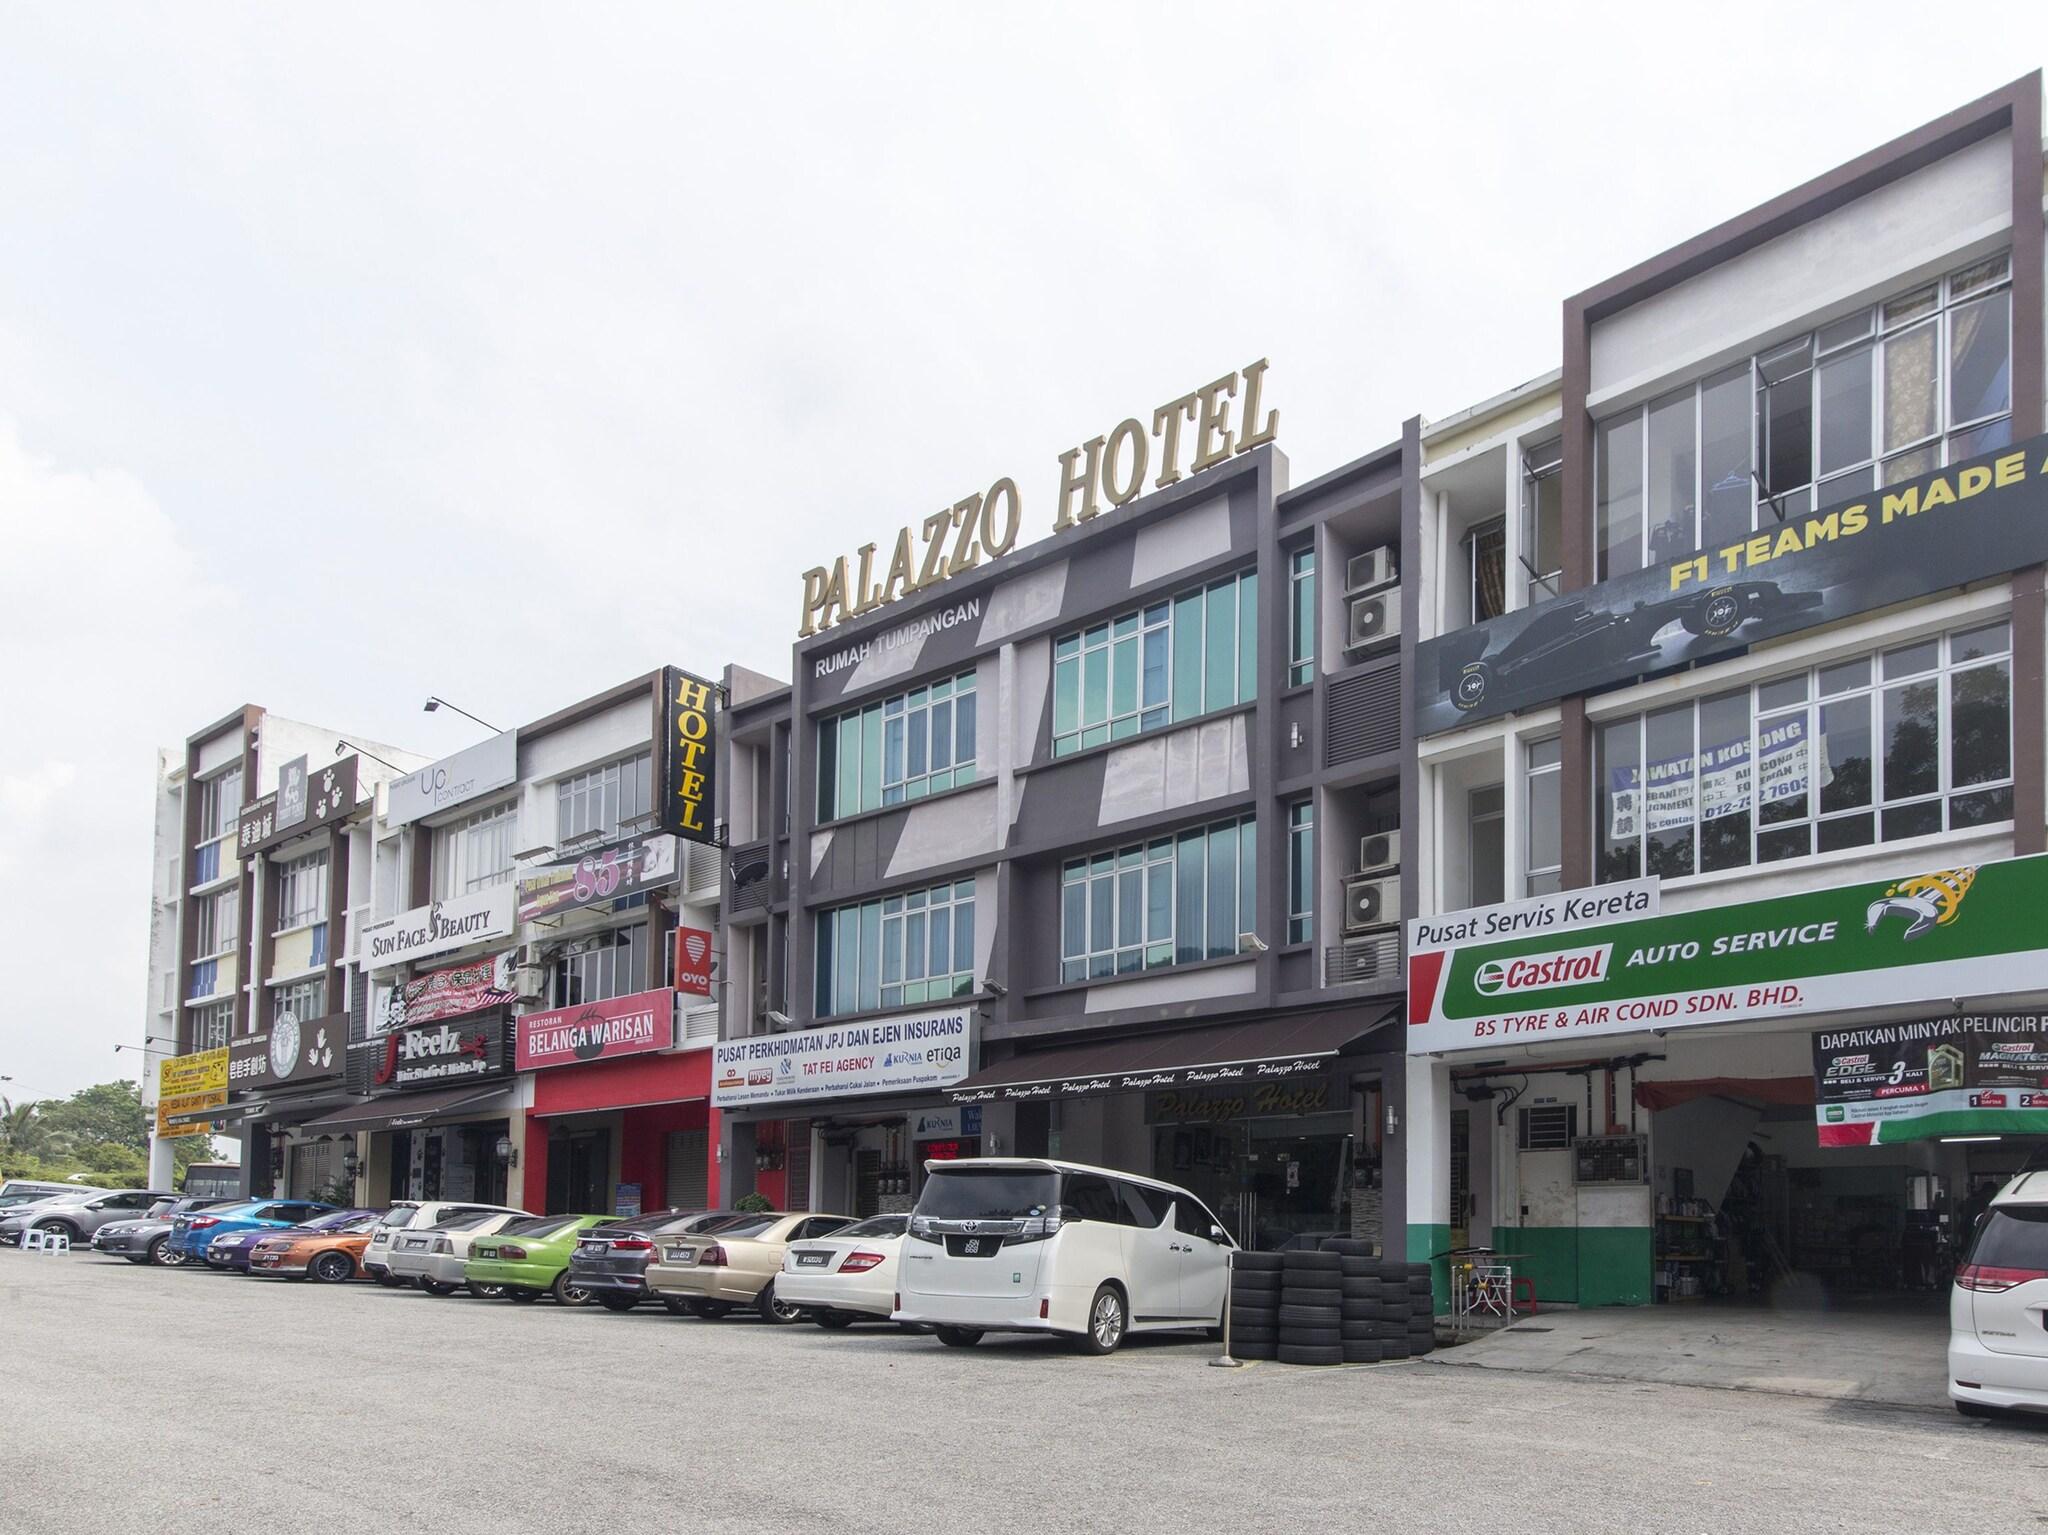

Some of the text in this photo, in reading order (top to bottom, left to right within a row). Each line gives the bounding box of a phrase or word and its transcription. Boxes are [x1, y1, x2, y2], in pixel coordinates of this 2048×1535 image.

[798, 357, 1280, 638] PALAZZO HOTEL
[1670, 450, 2026, 592] F1 TEAMS MADE
[814, 598, 982, 679] RUMAH TUMPANGAN
[675, 677, 710, 831] HOTEL
[1737, 766, 1792, 793] FOEMAN
[1638, 797, 1693, 813] IGNMENT
[1659, 815, 1697, 828] contac
[574, 848, 620, 902] 85
[1417, 890, 1649, 946] Pusat Servis Kereta
[1626, 921, 1838, 967] AUTO SERVICE
[1507, 950, 1603, 989] Castrol
[681, 972, 708, 986] OYO
[1474, 985, 1804, 1036] BS TYRE & AIR COND SDN. BHD.
[529, 1015, 562, 1029] RESTORAN
[529, 1014, 654, 1055] BELANGA WARISAN
[717, 1016, 963, 1063] PUSAT PERKHIDMATAN JPJ DAN EJEN INSURANS
[1821, 1027, 1895, 1050] DAPATKAN
[1899, 1018, 1961, 1041] MINYAK
[1963, 1016, 2037, 1033] PELINCIR
[2001, 1044, 2031, 1052] Castrol
[803, 1056, 875, 1075] TAT FEI AGENCY
[1257, 1060, 1320, 1075] Palazzo Hotel
[1841, 1055, 1867, 1065] Castrol
[1187, 1067, 1244, 1081] Palazzo Hotel
[1825, 1063, 1877, 1077] EDGE
[1888, 1061, 1906, 1085] 3
[1061, 1080, 1112, 1092] Palazzo Hotel
[1122, 1074, 1175, 1087] Palazzo Hotel
[1863, 1075, 1886, 1083] SERVIS
[952, 1090, 996, 1103] Palazzo Hotel
[1005, 1086, 1051, 1098] Palazzo Hotel
[1881, 1086, 1919, 1095] PERCUMA
[1155, 1083, 1328, 1122] Palazzo Hotel
[1971, 1096, 1978, 1106] 1
[2022, 1096, 2030, 1106] 2
